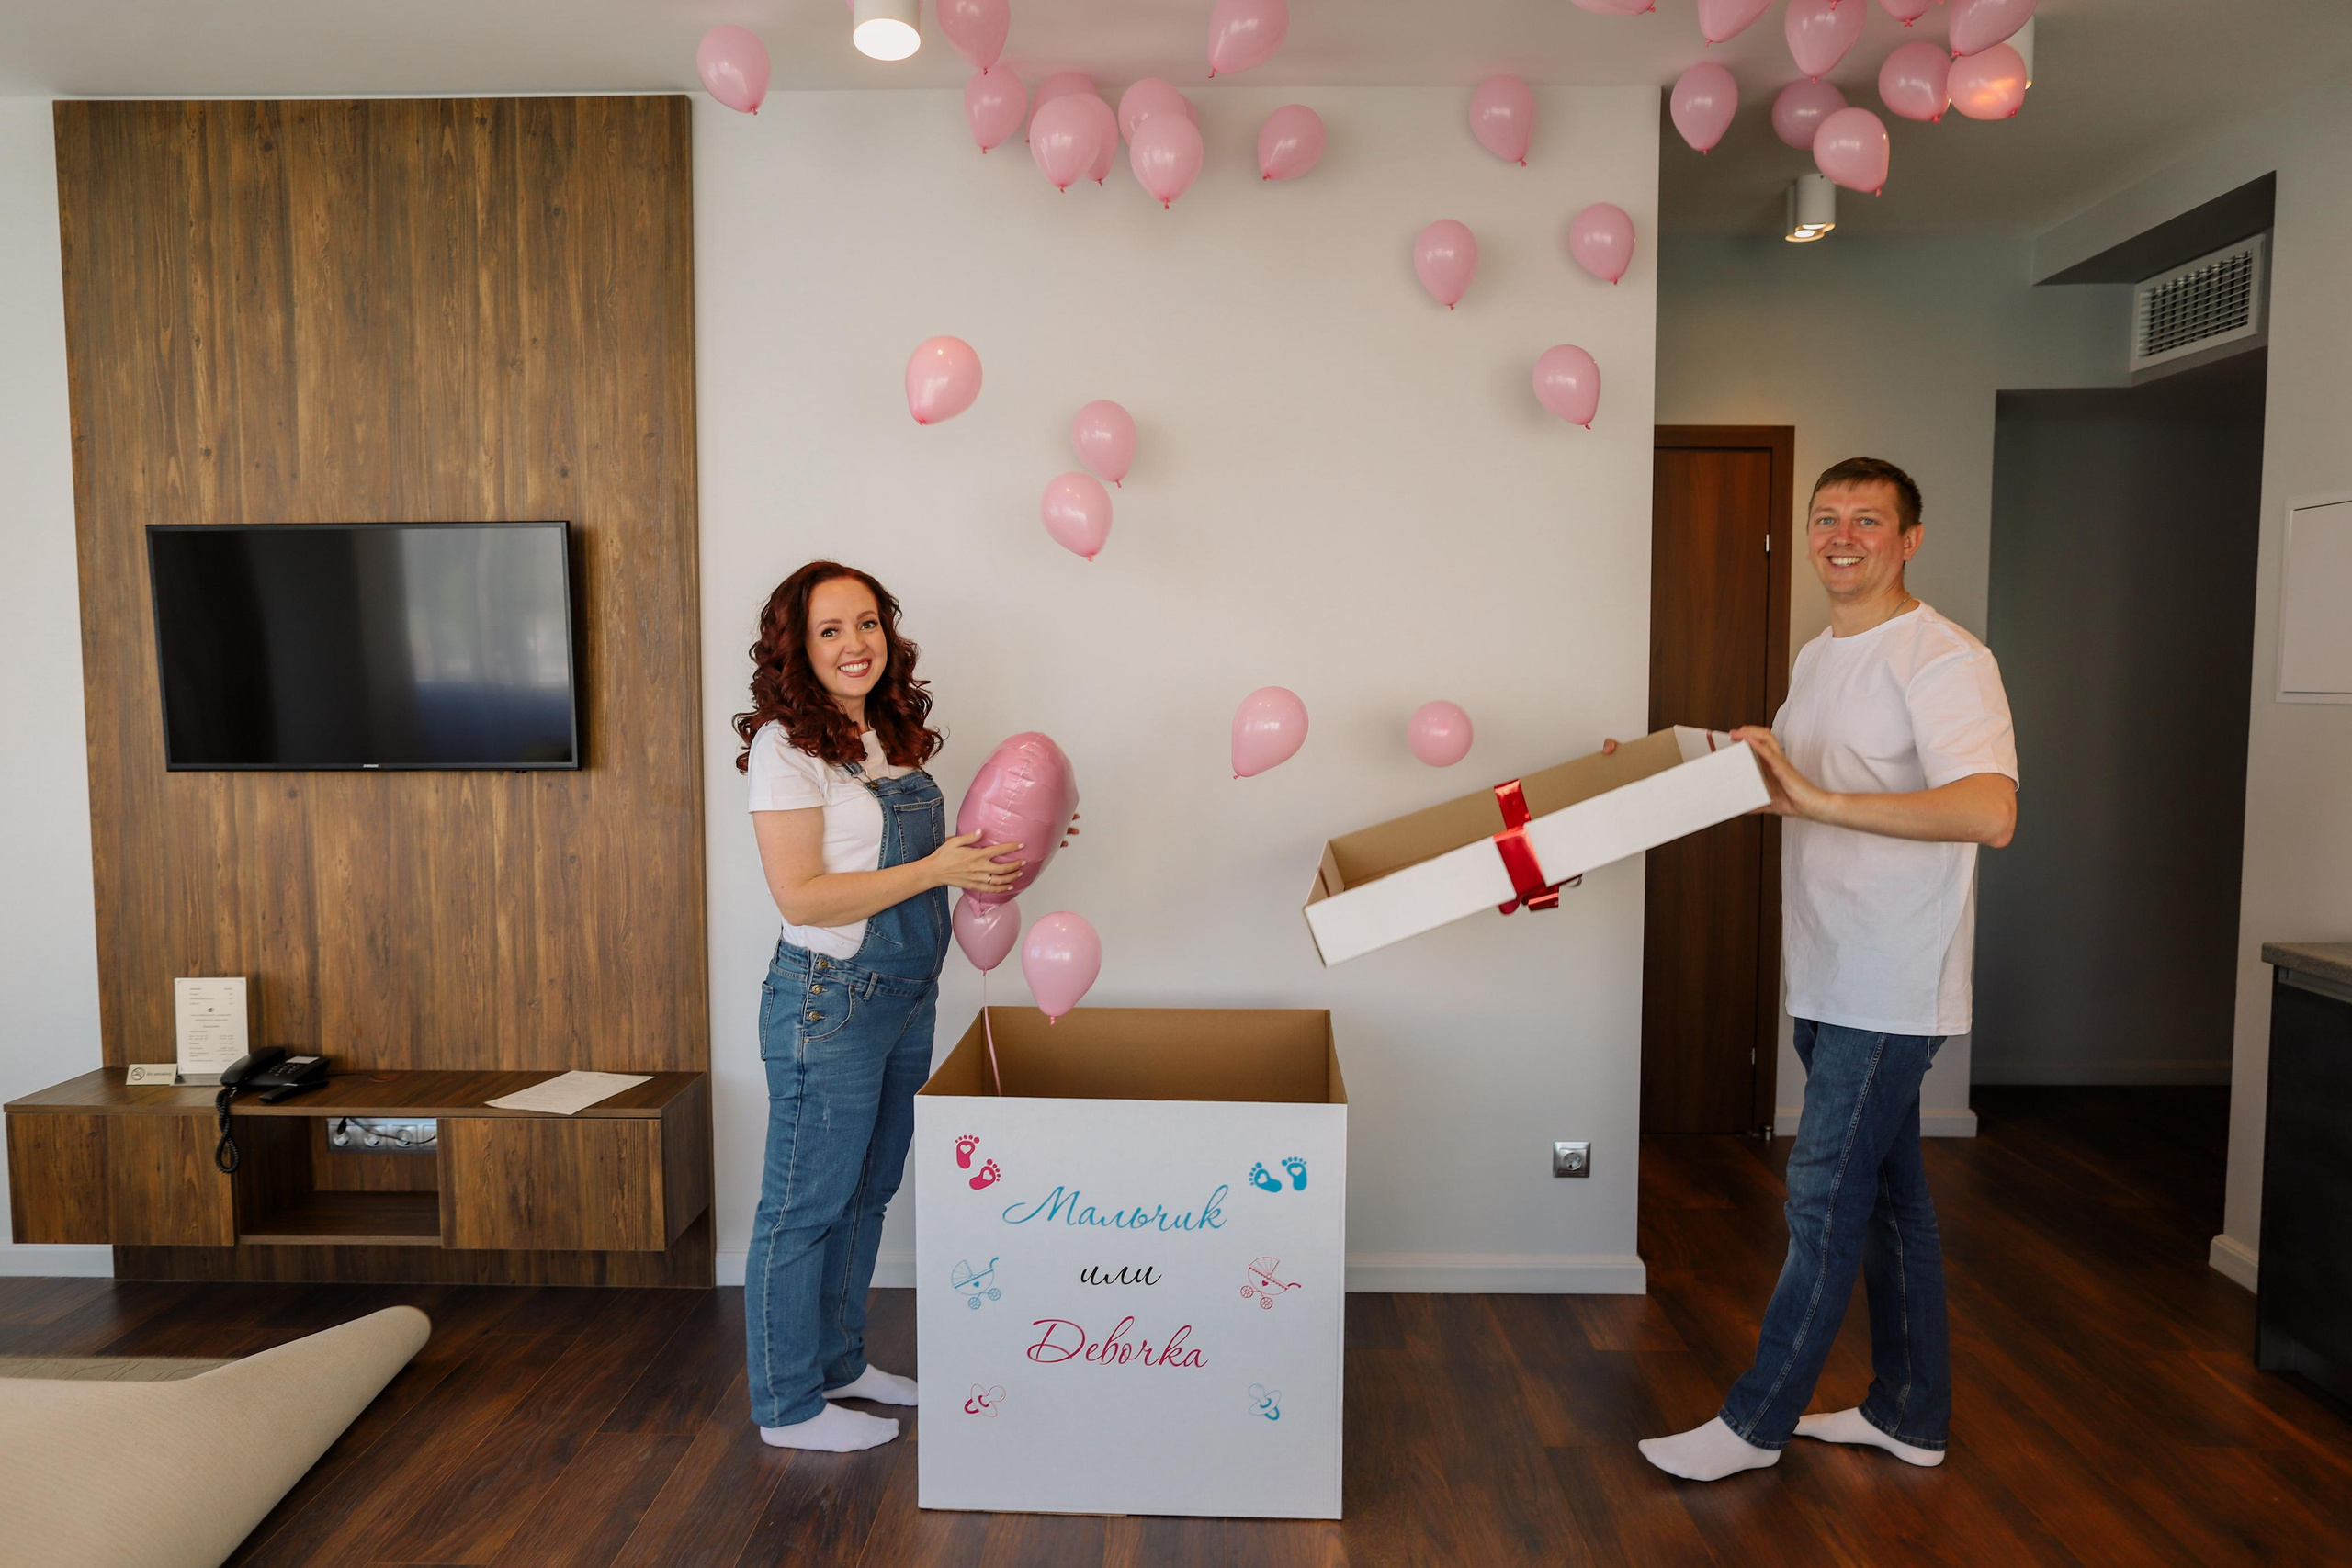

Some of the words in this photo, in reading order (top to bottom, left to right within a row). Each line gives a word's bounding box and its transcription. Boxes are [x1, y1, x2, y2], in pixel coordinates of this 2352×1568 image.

[1002, 1185, 1229, 1231] Мальчик
[1080, 1265, 1162, 1286] или
[1026, 1315, 1208, 1368] Девочка
